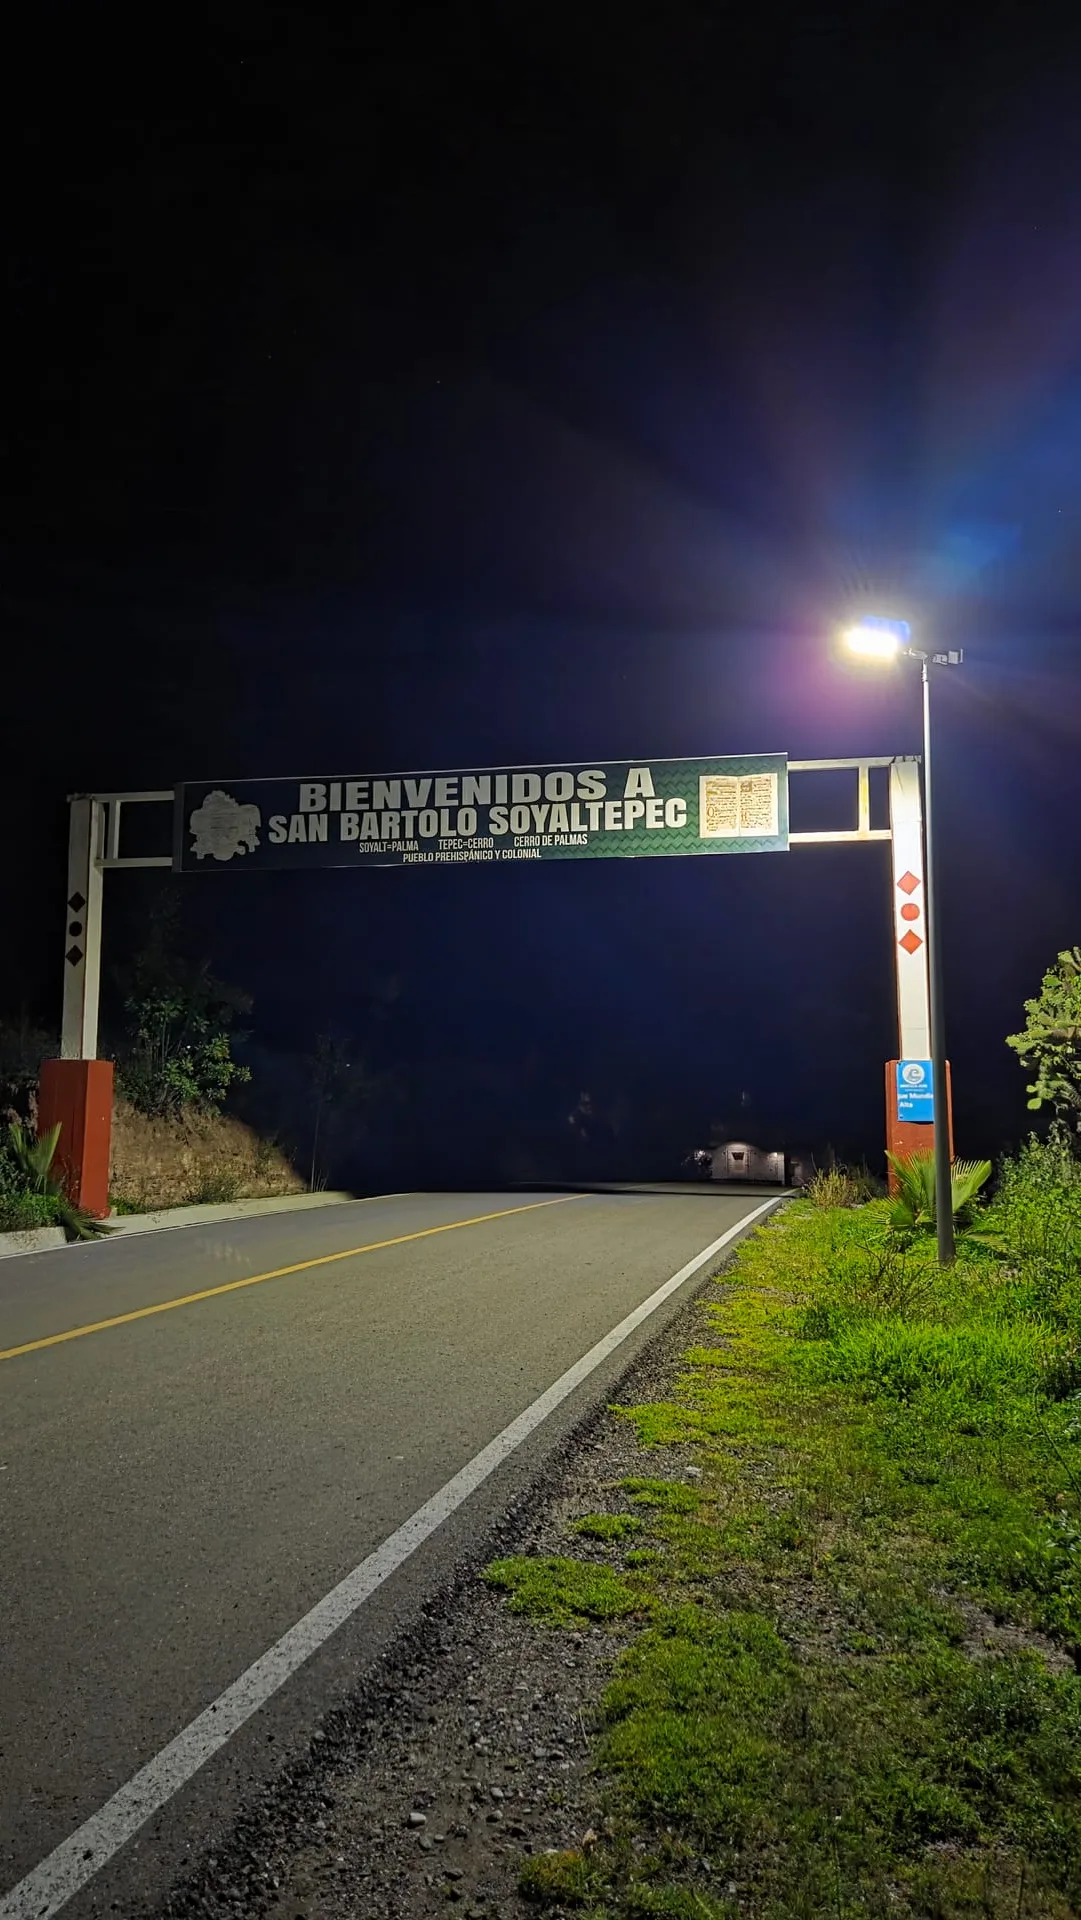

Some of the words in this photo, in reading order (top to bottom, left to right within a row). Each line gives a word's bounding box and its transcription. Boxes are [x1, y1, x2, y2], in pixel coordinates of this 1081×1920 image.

[299, 769, 607, 813] BIENVENIDOS
[623, 767, 656, 799] A
[268, 813, 329, 844] SAN
[340, 807, 477, 842] BARTOLO
[488, 797, 687, 835] SOYALTEPEC
[359, 839, 420, 854] SOYALT=PALMA
[437, 837, 495, 851] TEPEC=CERRO
[513, 835, 541, 848] CERRO
[541, 834, 553, 846] DE
[554, 833, 588, 846] PALMAS
[403, 852, 434, 864] PUEBLO
[435, 848, 494, 863] PREHISPÁNICO
[495, 850, 502, 860] Y
[502, 848, 542, 861] COLONIAL
